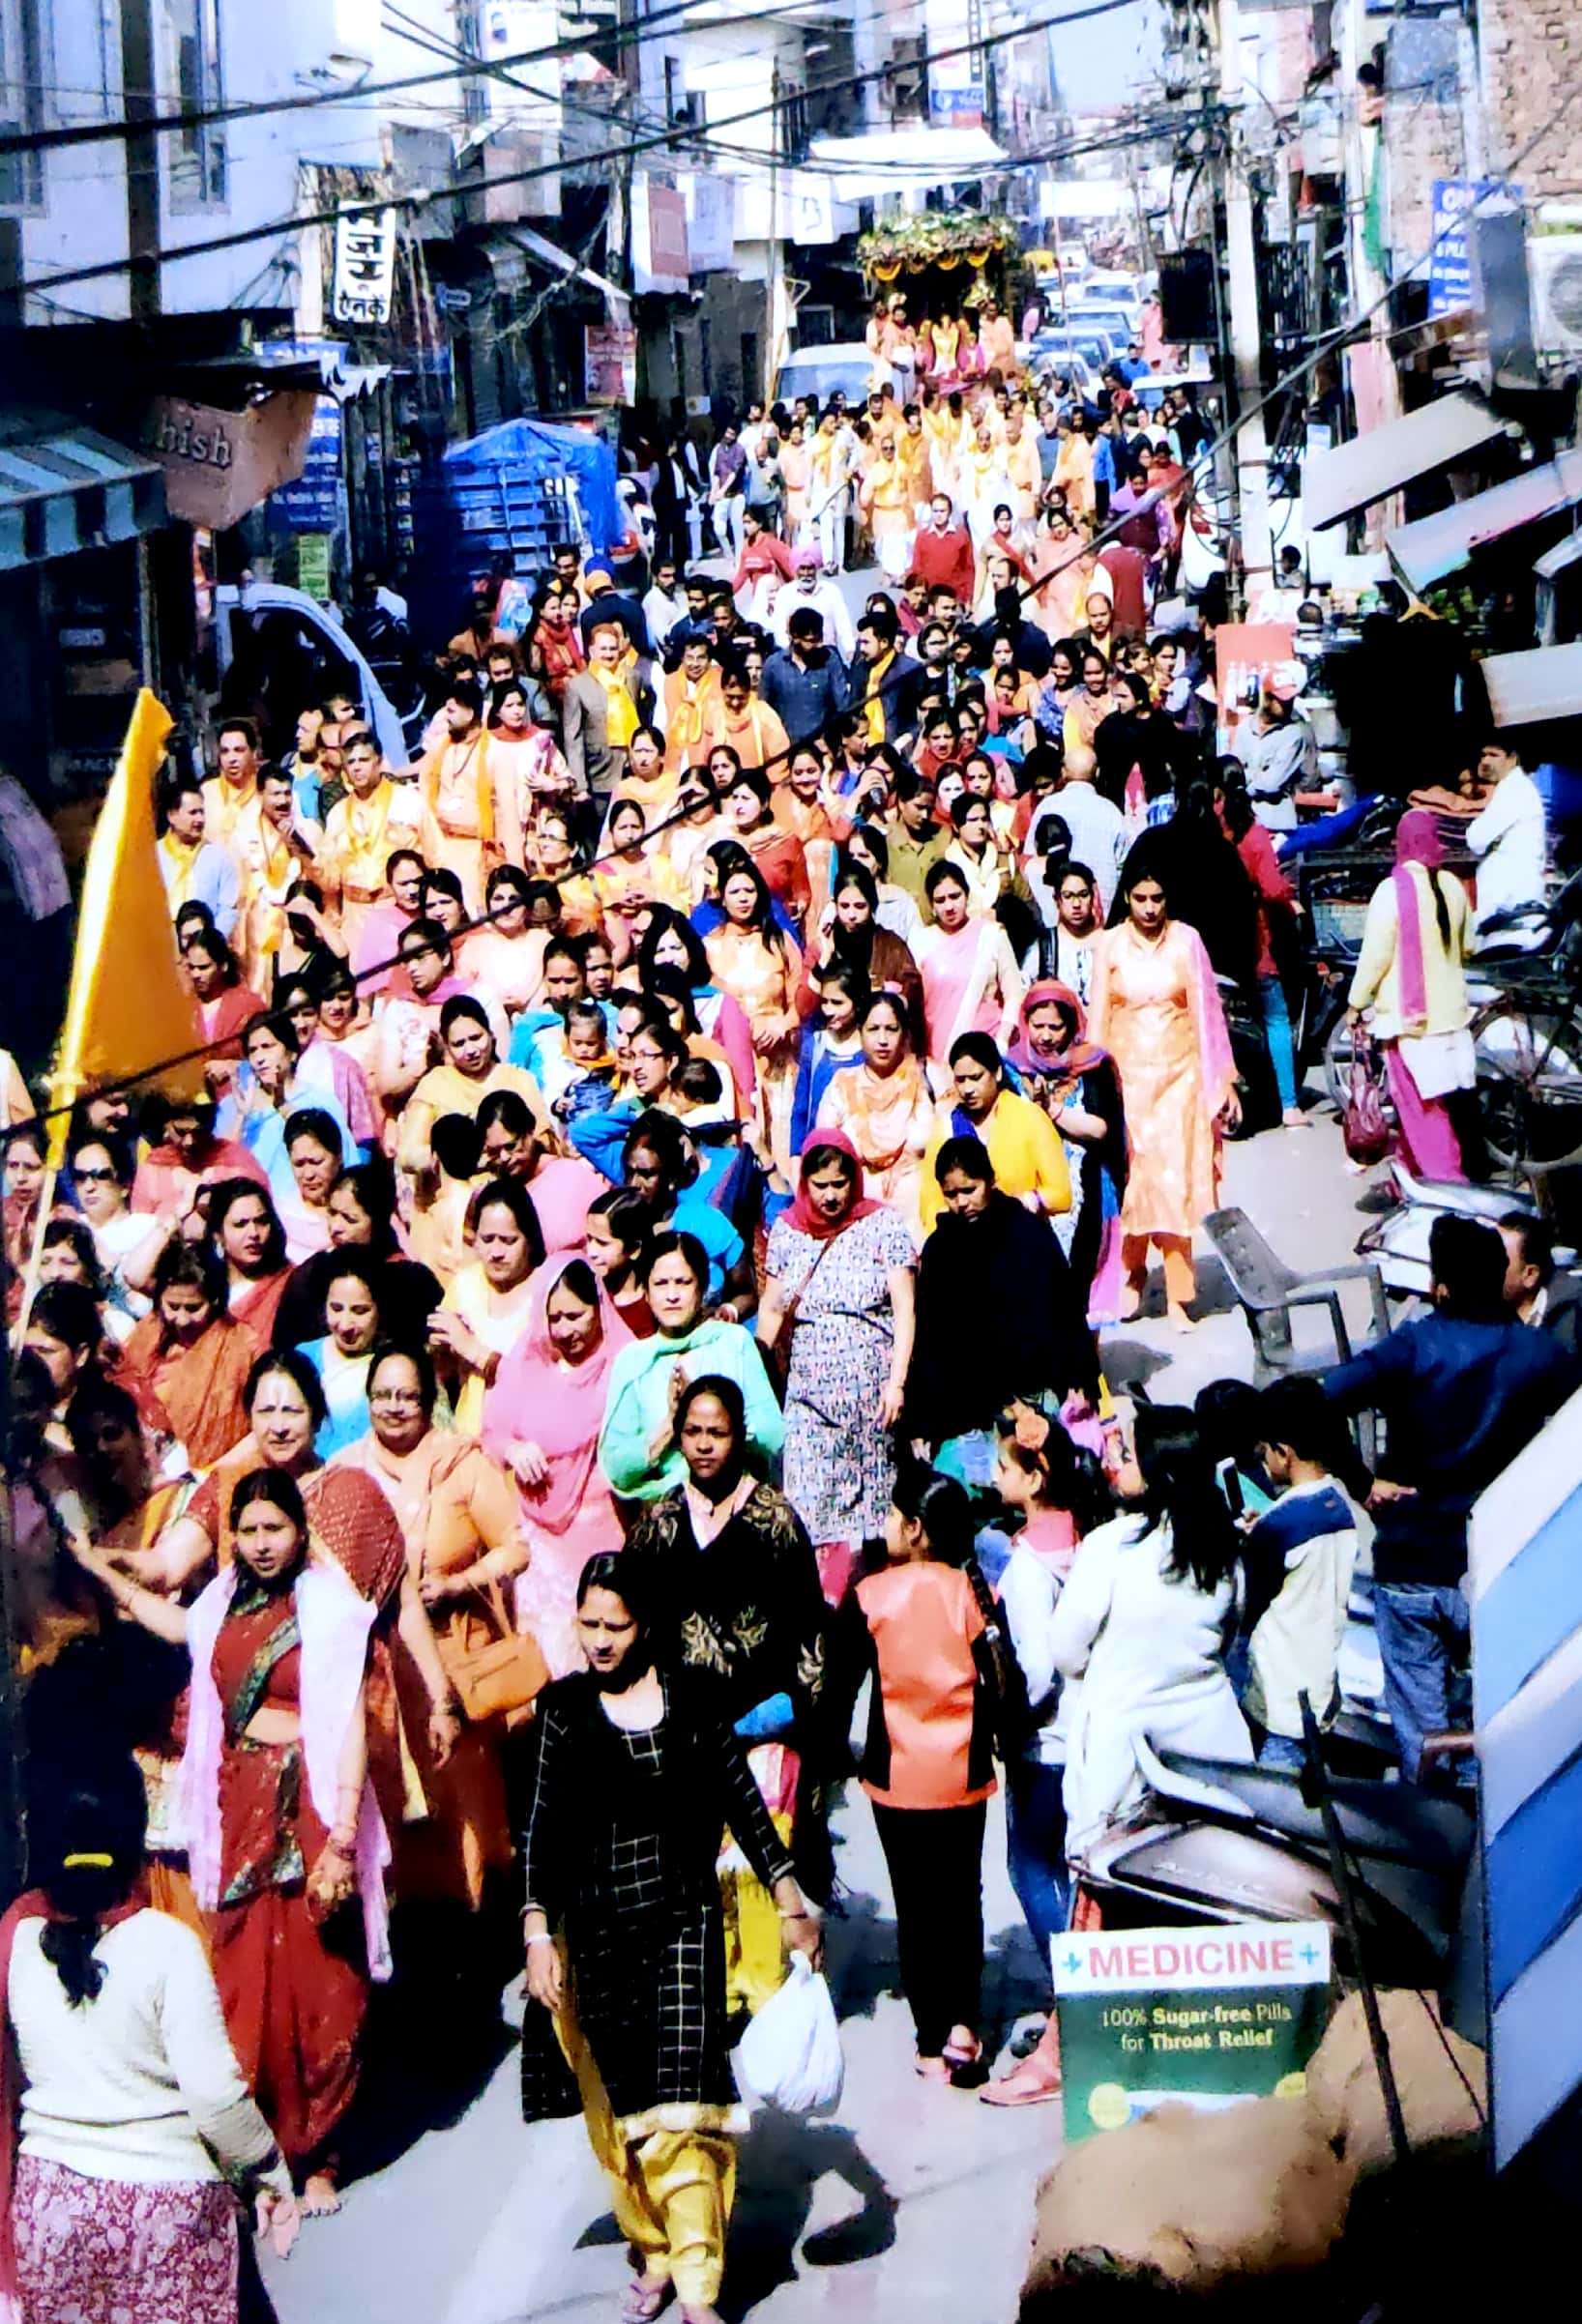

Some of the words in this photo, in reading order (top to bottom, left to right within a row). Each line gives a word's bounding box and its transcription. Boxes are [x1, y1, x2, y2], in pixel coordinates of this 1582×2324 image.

[1088, 1939, 1297, 1979] MEDICINE
[1102, 2008, 1148, 2027] 100%
[1152, 2005, 1253, 2028] Sugar-free
[1256, 2003, 1292, 2023] Pills
[1121, 2033, 1145, 2051] for
[1150, 2030, 1212, 2050] Throat
[1218, 2027, 1275, 2048] Relief
